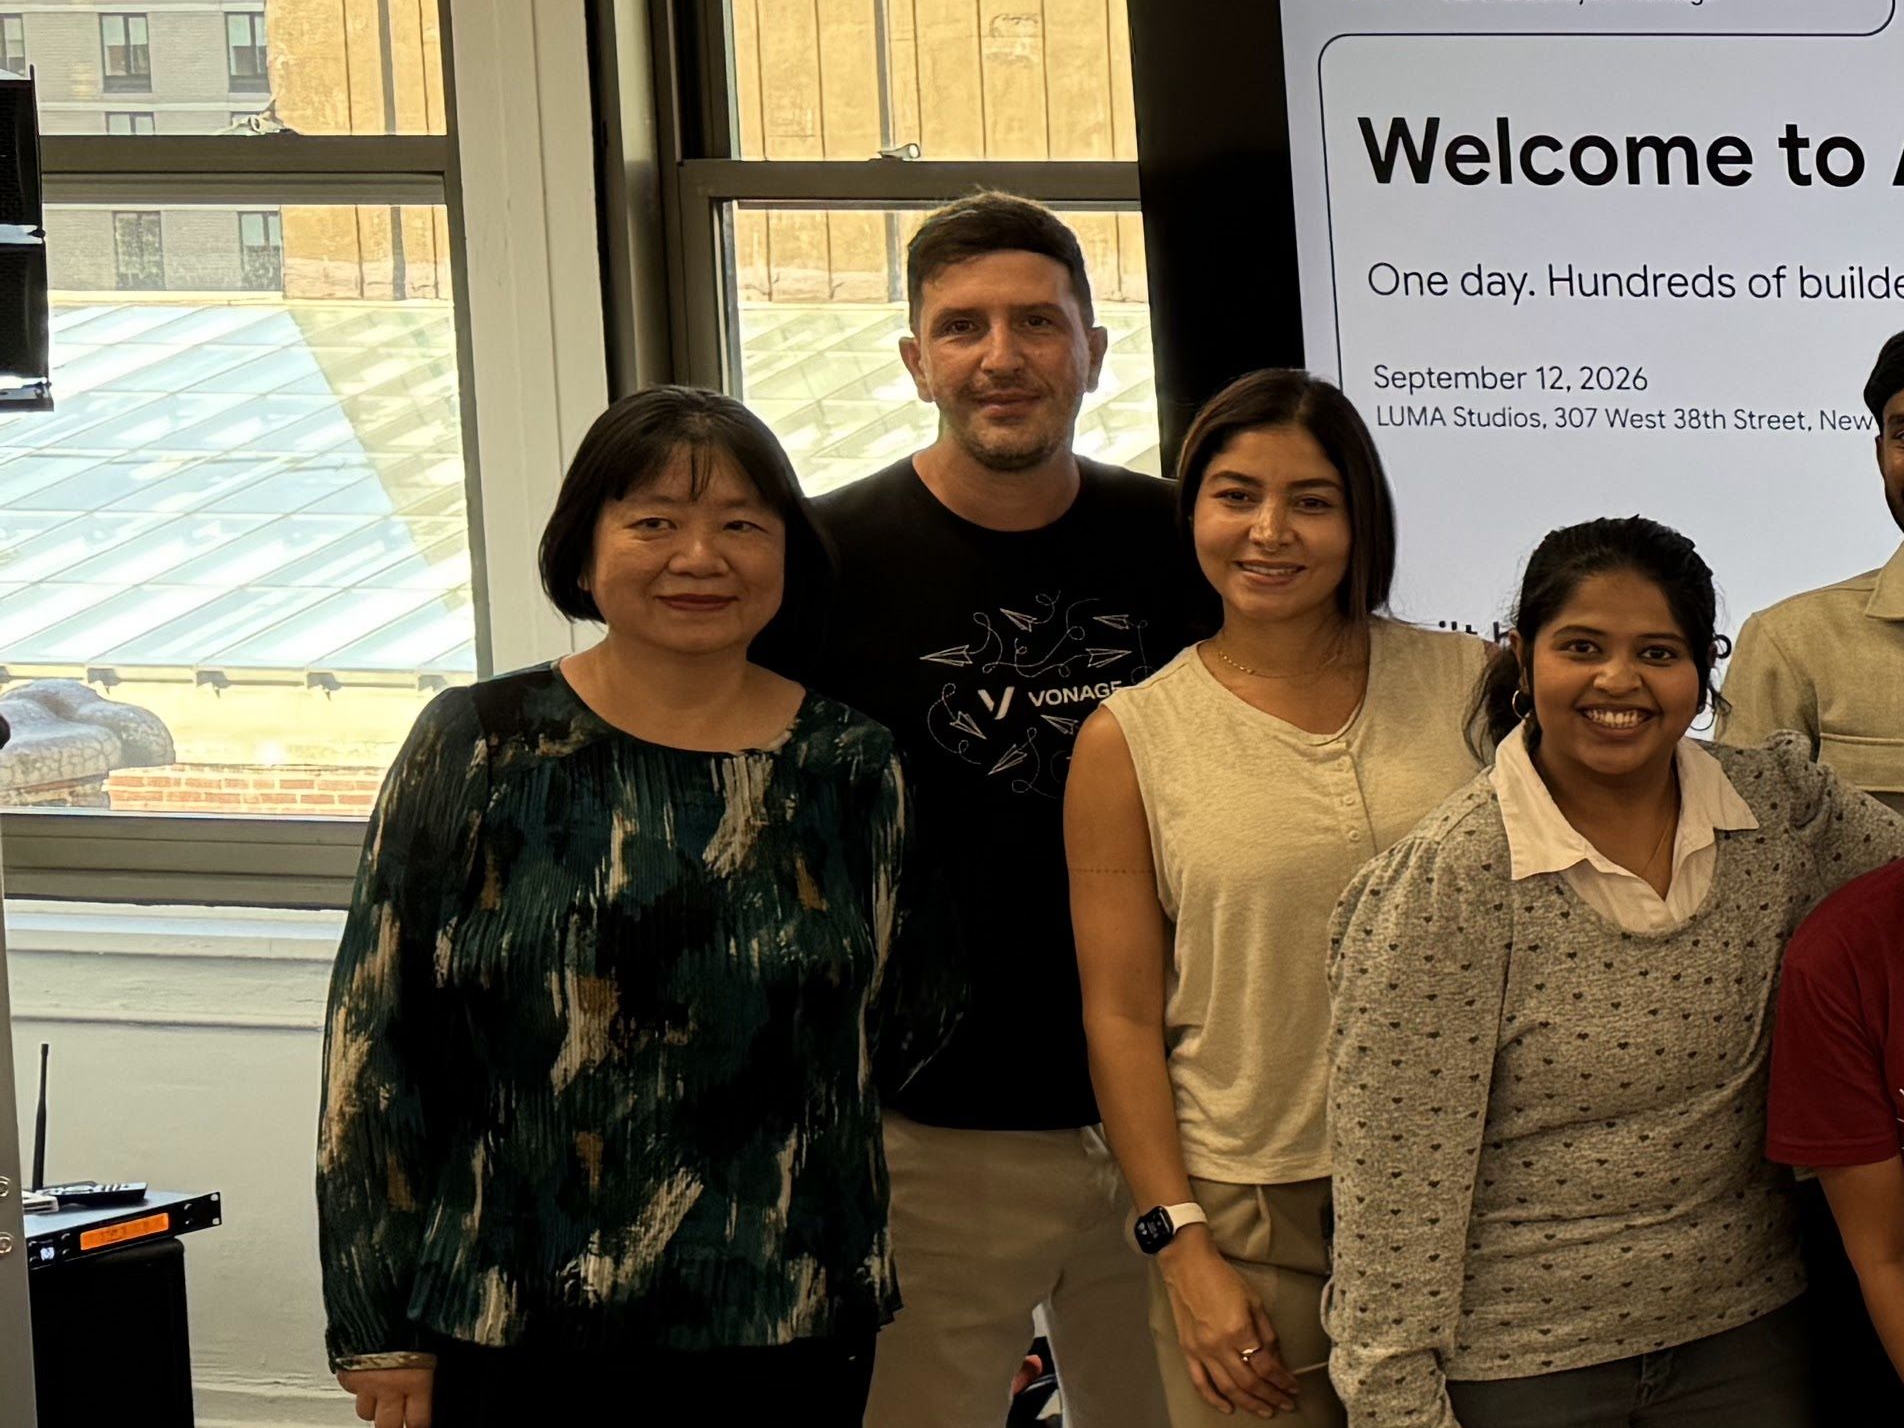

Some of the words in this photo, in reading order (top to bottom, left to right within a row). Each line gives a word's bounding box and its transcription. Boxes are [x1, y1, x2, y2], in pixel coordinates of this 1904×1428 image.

[1357, 116, 1754, 187] Welcome
[1777, 123, 1866, 188] to
[1367, 262, 1449, 297] One
[1460, 263, 1537, 306] day.
[1548, 263, 1736, 299] Hundreds
[1747, 264, 1788, 299] of
[1374, 364, 1528, 395] September
[1535, 365, 1573, 393] 12,
[1579, 366, 1649, 392] 2026
[1376, 405, 1447, 428] LUMA
[1453, 406, 1547, 430] Studios,
[1554, 407, 1598, 429] 307
[1604, 408, 1667, 430] West
[1673, 408, 1727, 431] 38th
[1733, 409, 1814, 432] Street,
[1819, 409, 1873, 432] New
